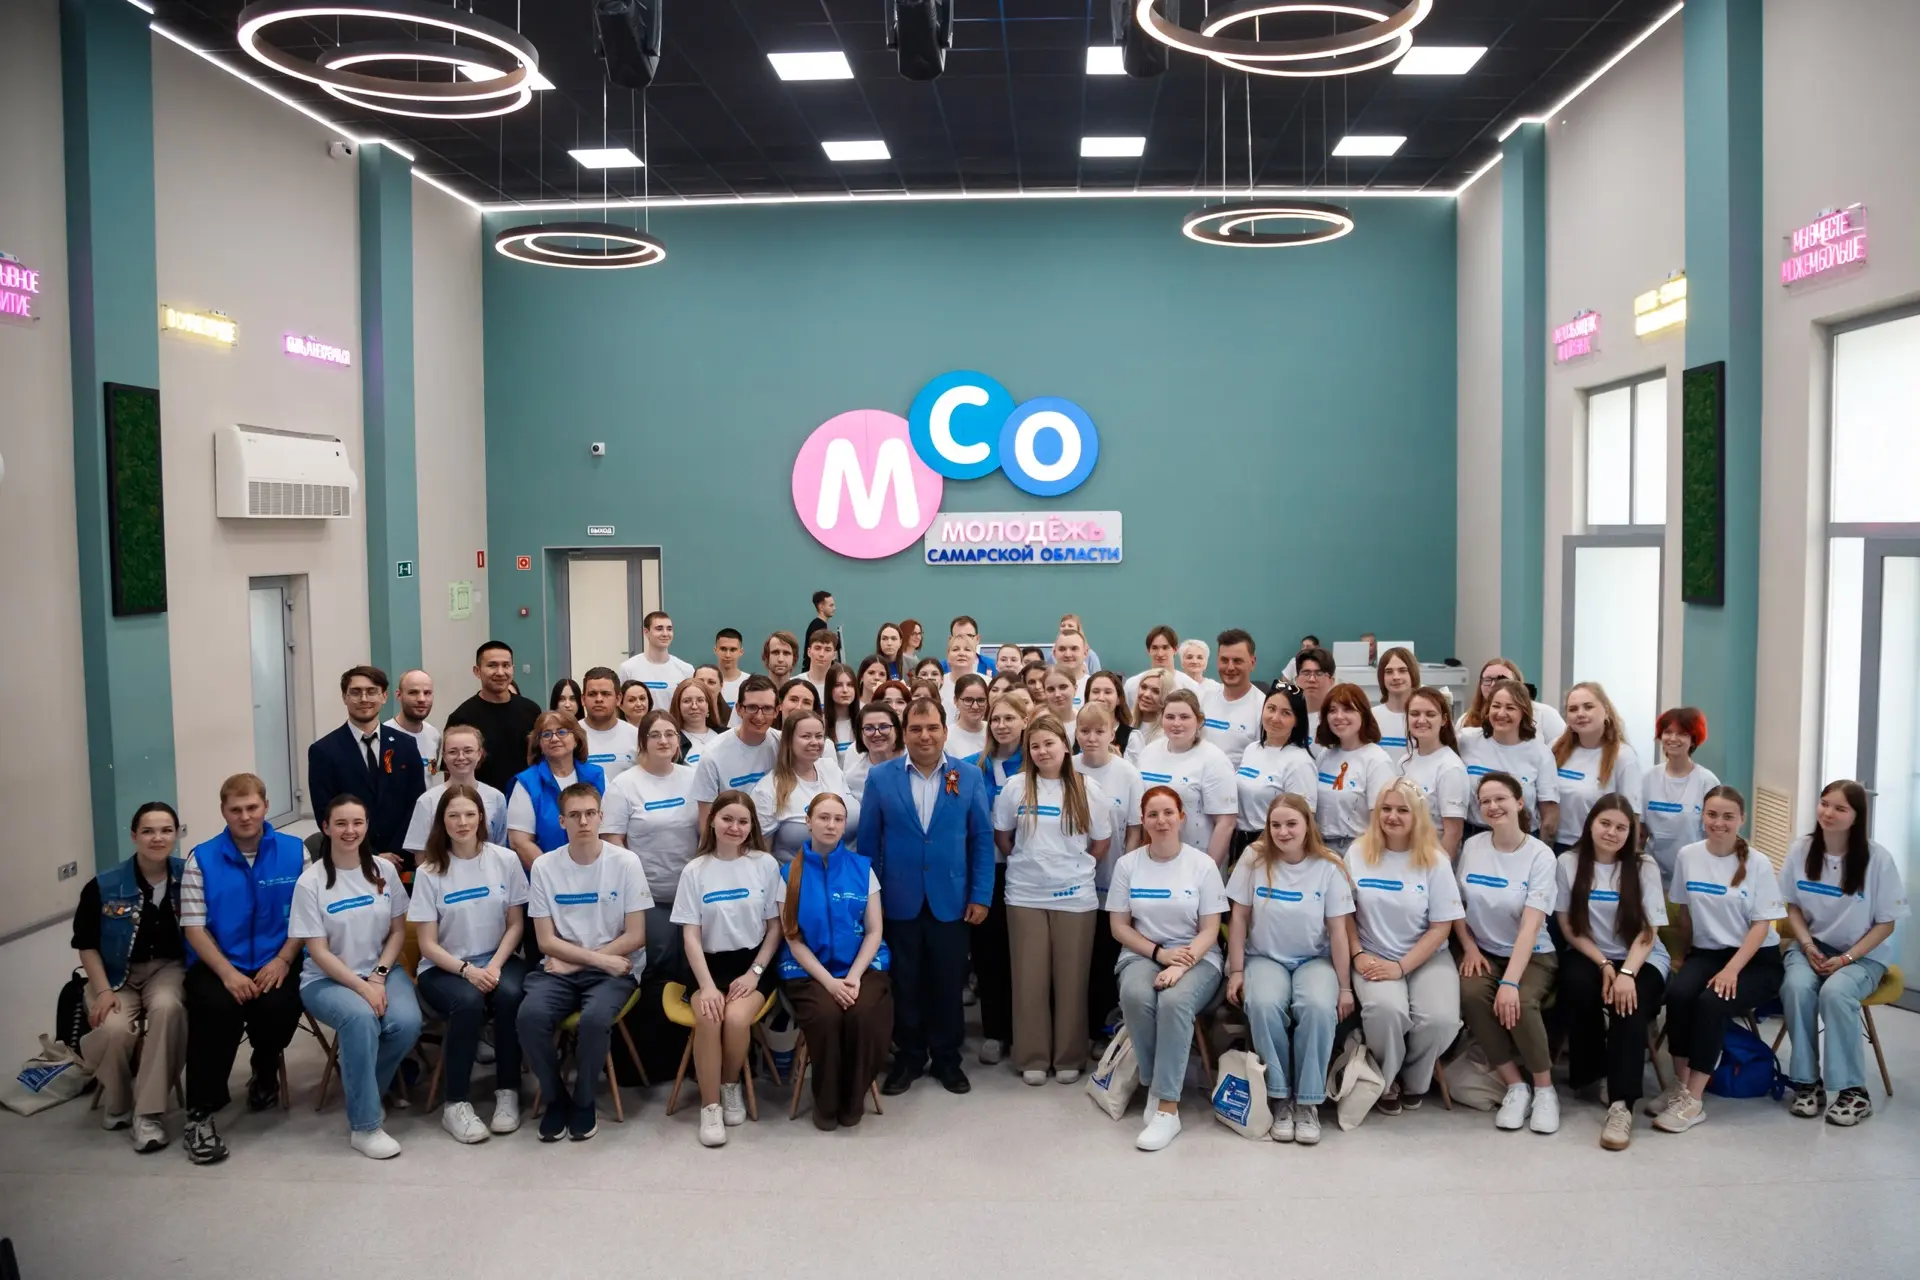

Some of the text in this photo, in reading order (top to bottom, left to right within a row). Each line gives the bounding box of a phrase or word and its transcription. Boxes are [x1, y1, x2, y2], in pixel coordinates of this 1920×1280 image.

[1809, 211, 1849, 247] ВМЕСТЕ
[1819, 234, 1867, 270] БОЛЬШЕ
[0, 263, 40, 294] ЫВНОЕ
[0, 289, 31, 317] ИТИЕ
[941, 514, 1105, 547] МОЛОДЁЖЬ
[927, 545, 1120, 562] САМАРСКОЙ ОБЛАСТИ
